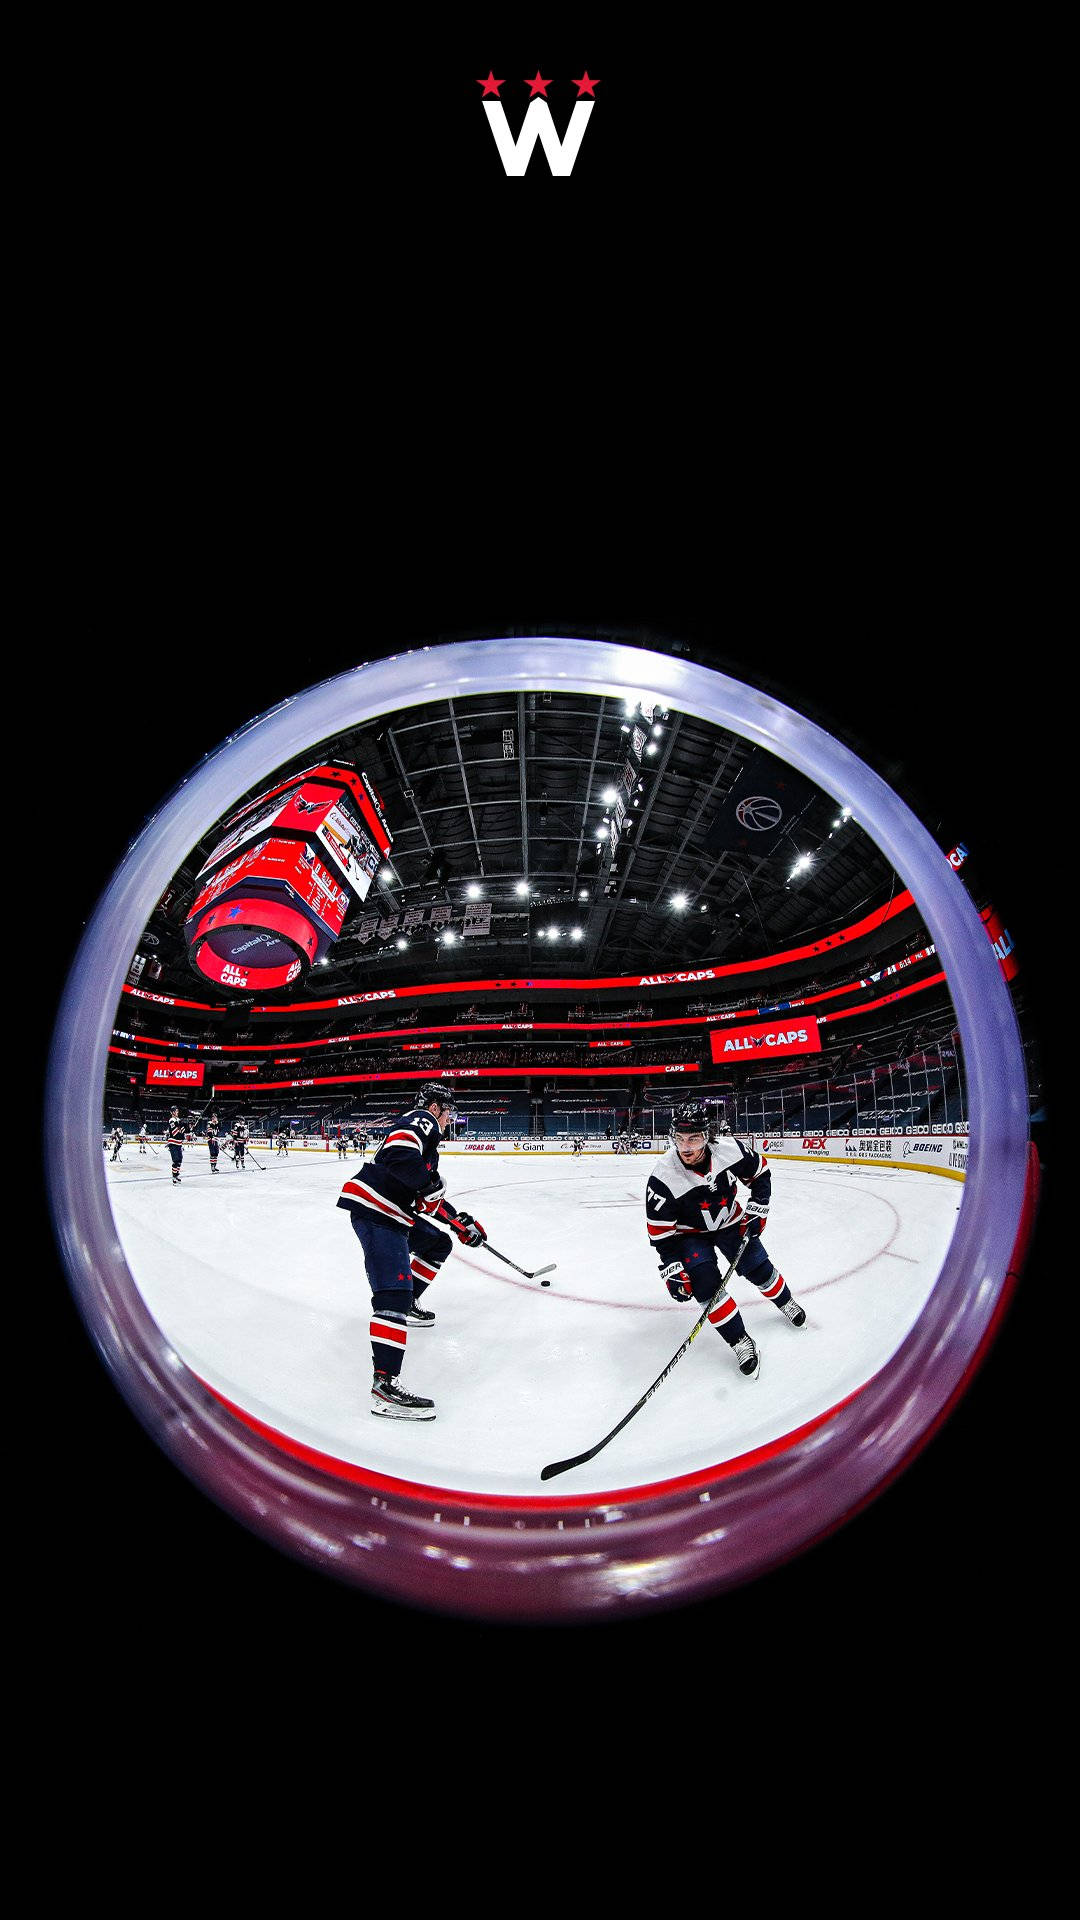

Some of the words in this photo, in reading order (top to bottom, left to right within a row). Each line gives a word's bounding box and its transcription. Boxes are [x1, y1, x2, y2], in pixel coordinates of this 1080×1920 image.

[223, 964, 241, 977] ALL
[220, 973, 248, 987] CAPS
[640, 976, 666, 985] ALL
[677, 970, 715, 982] CAPS
[130, 989, 145, 998] ALL
[152, 994, 174, 1004] CAPS
[338, 996, 358, 1005] ALL
[365, 991, 396, 1000] CAPS
[724, 1037, 753, 1052] ALL
[766, 1030, 807, 1046] CAPS
[175, 1071, 197, 1079] CAPS
[880, 1126, 903, 1136] GEICO
[906, 1125, 929, 1135] GEICO
[522, 1142, 545, 1151] Giant
[802, 1138, 827, 1150] DEX
[912, 1143, 943, 1153] BOEING
